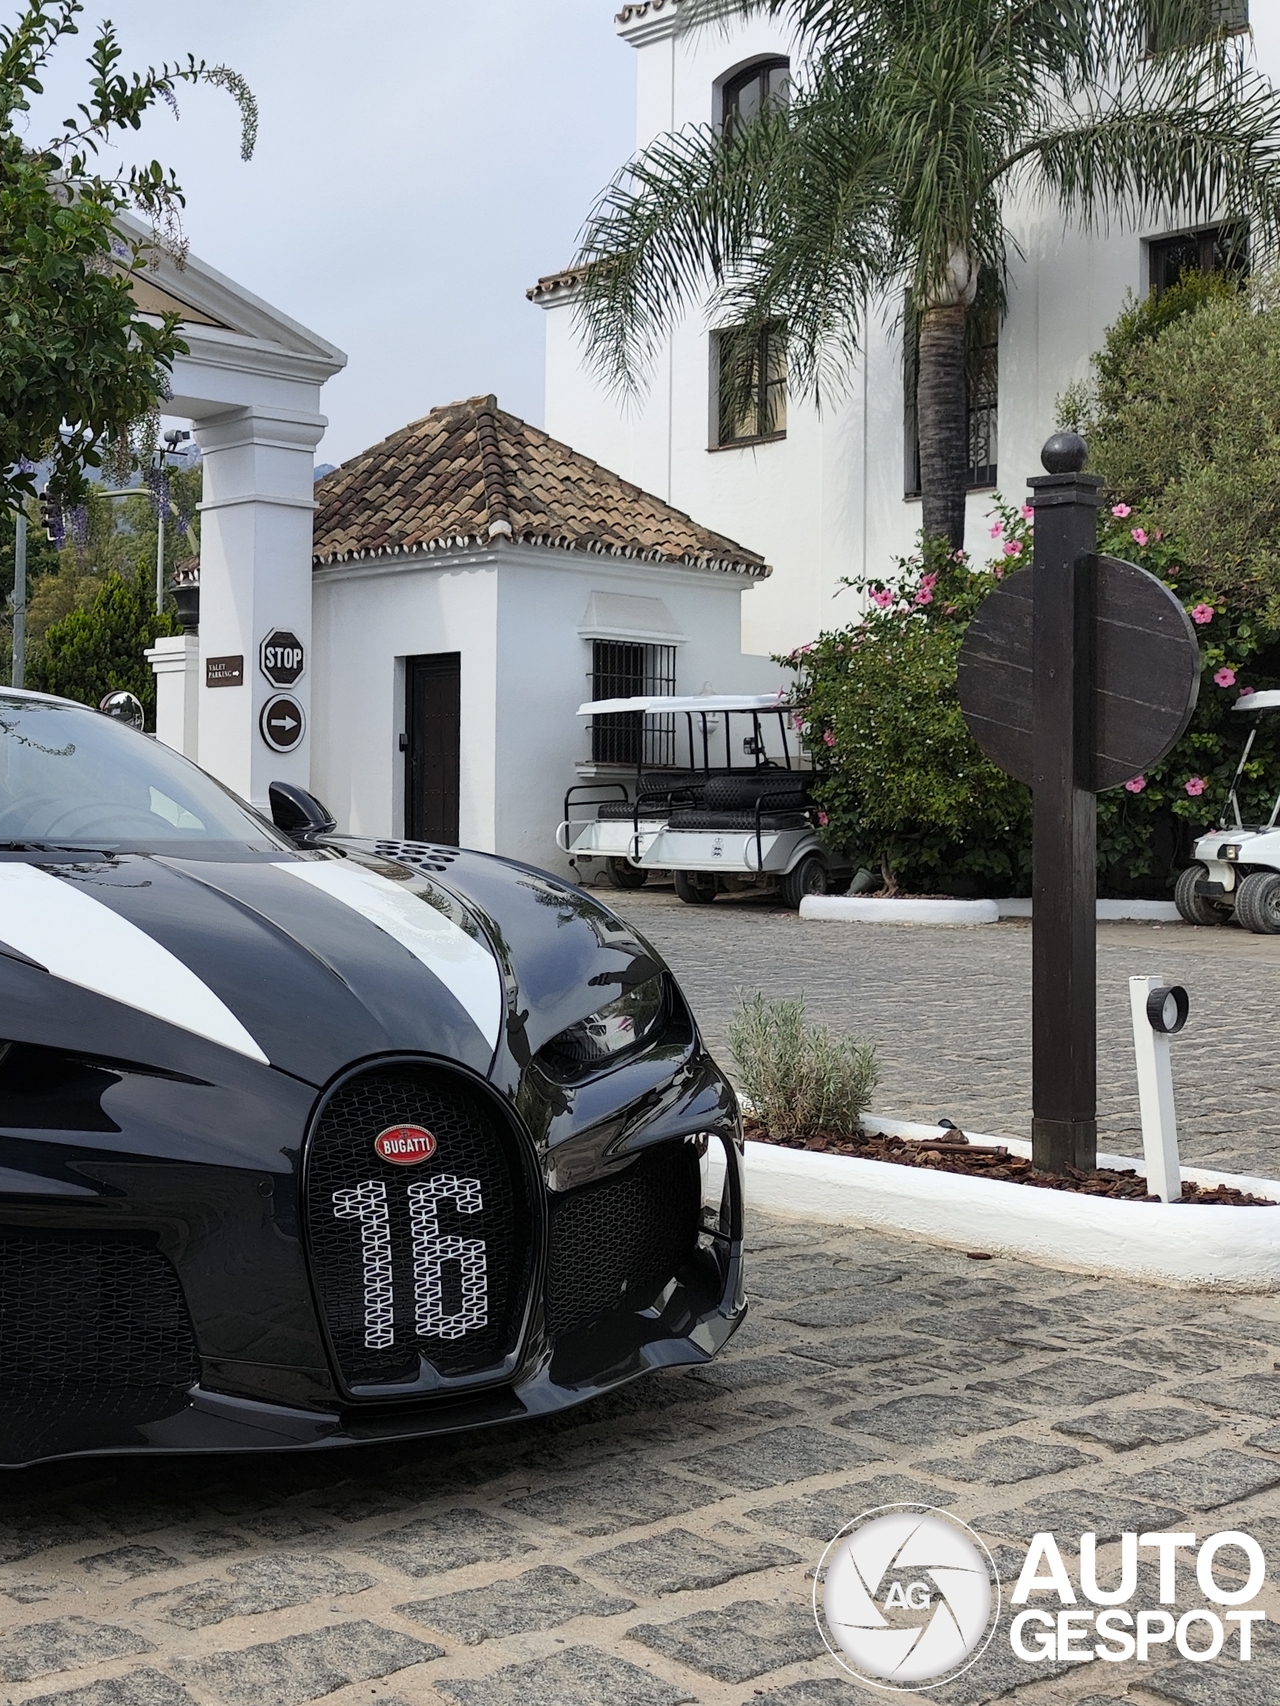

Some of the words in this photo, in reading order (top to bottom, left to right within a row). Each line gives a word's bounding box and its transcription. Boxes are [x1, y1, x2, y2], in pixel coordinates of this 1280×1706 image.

[266, 646, 302, 669] STOP
[208, 670, 232, 678] PARKING
[383, 1137, 431, 1155] BUGATTI
[332, 1173, 488, 1349] 16
